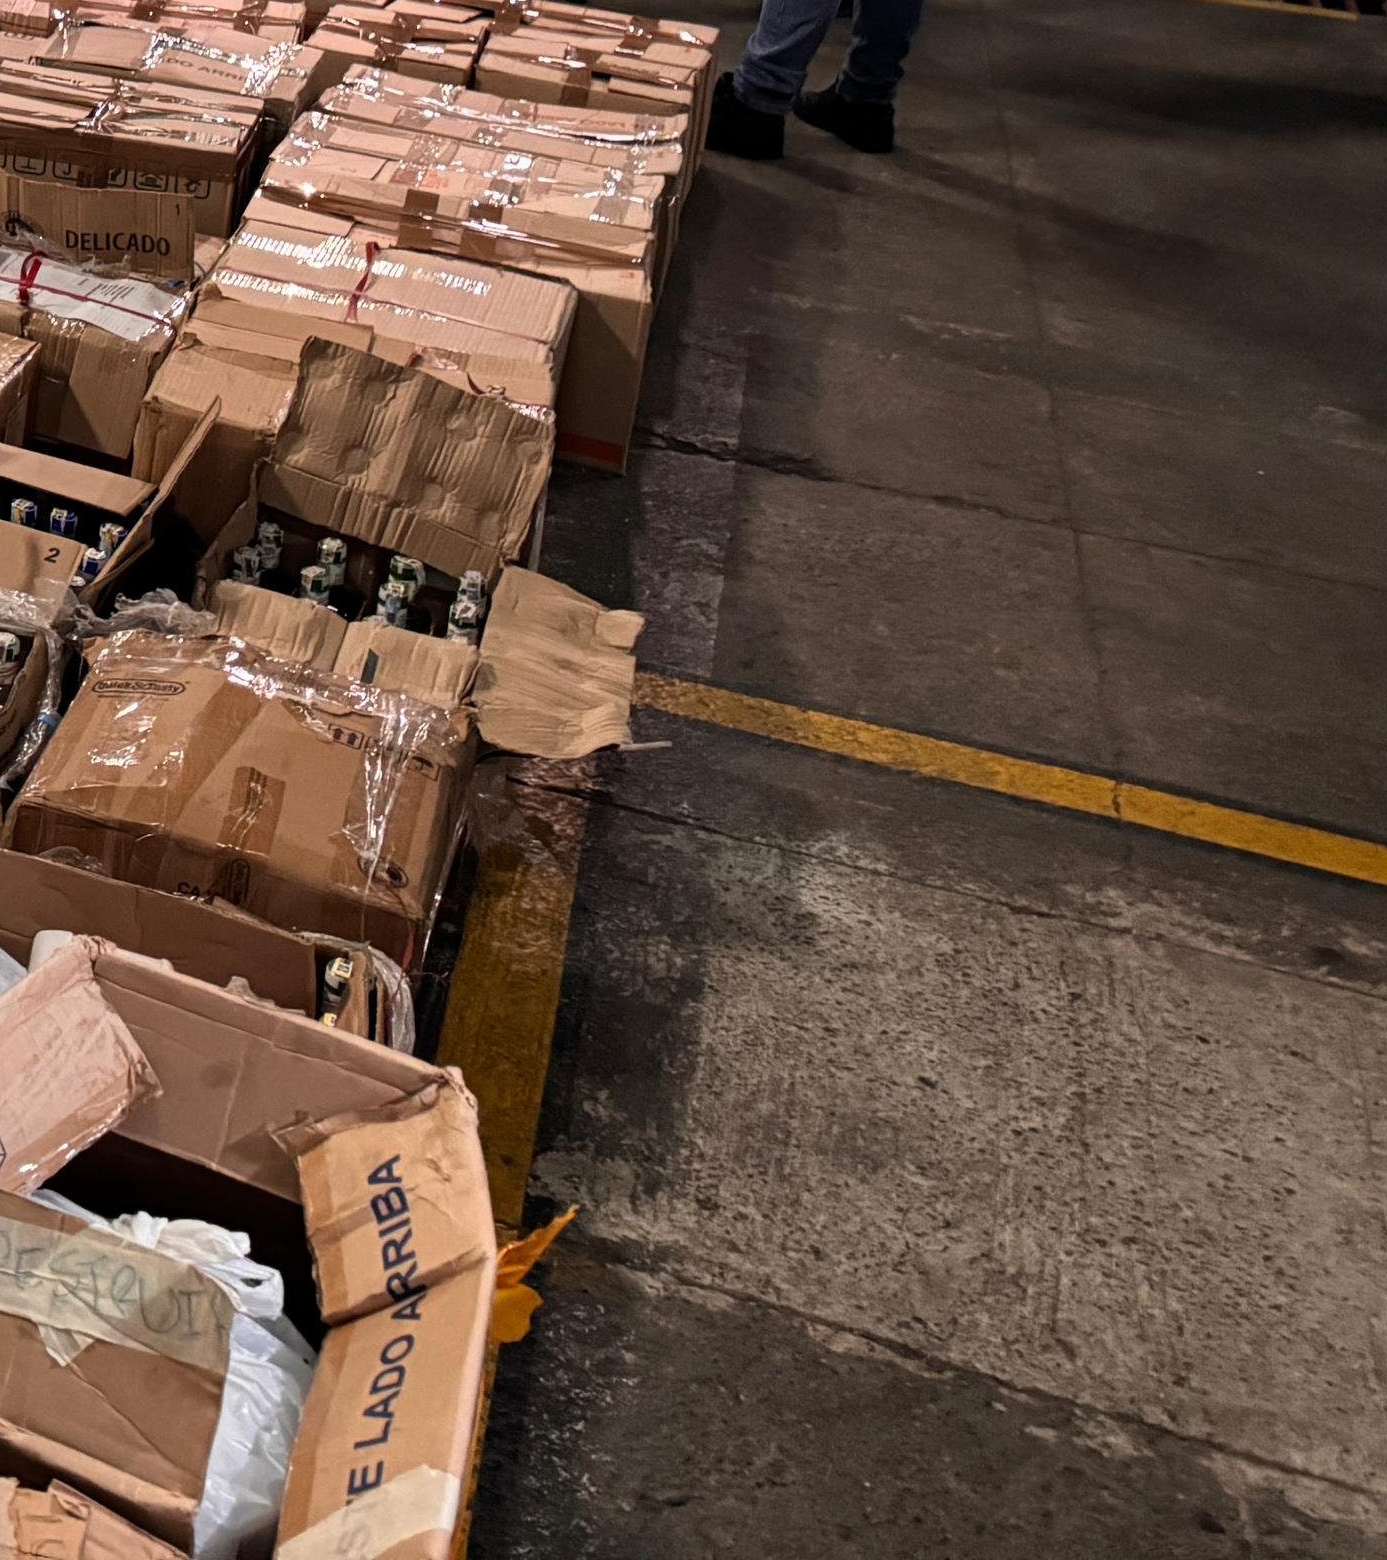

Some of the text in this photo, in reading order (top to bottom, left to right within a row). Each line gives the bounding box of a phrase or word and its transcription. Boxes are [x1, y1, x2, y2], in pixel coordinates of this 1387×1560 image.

[65, 229, 171, 257] DELICADO
[44, 546, 61, 564] 2
[367, 1153, 429, 1322] ARRIBA
[354, 1333, 415, 1451] LADO
